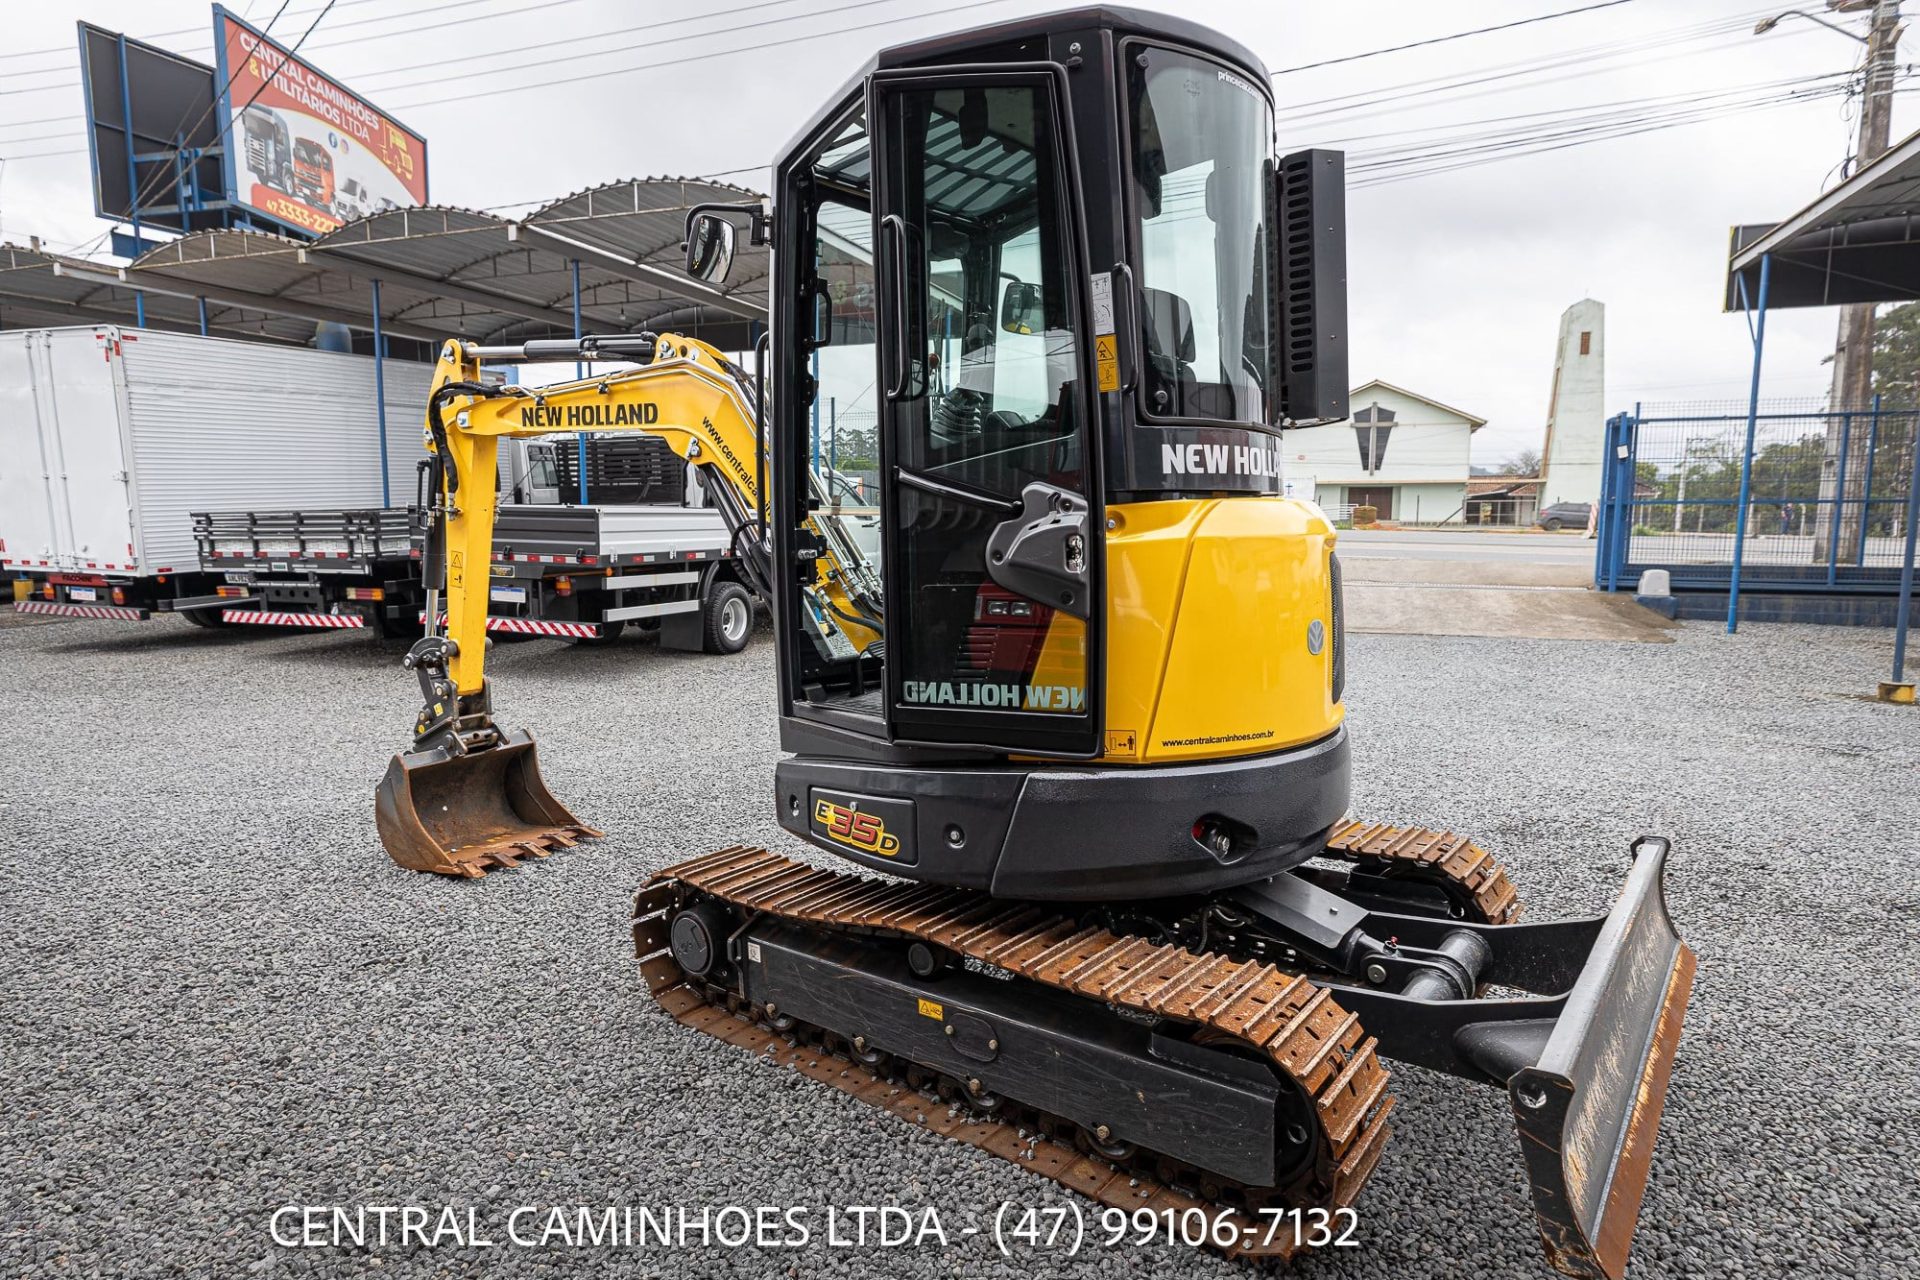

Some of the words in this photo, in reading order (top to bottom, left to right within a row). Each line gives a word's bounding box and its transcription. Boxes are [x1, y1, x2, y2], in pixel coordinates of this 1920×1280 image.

[240, 33, 306, 85] CENTRAL
[306, 74, 379, 130] CAMINHÕES
[250, 58, 259, 78] &
[260, 63, 341, 125] UTILITÁRIOS
[341, 113, 370, 142] LTDA
[521, 405, 563, 427] NEW
[567, 402, 658, 427] HOLLAND
[1161, 443, 1229, 474] NEW
[1161, 730, 1275, 747] www.centralcaminhoes.com.br
